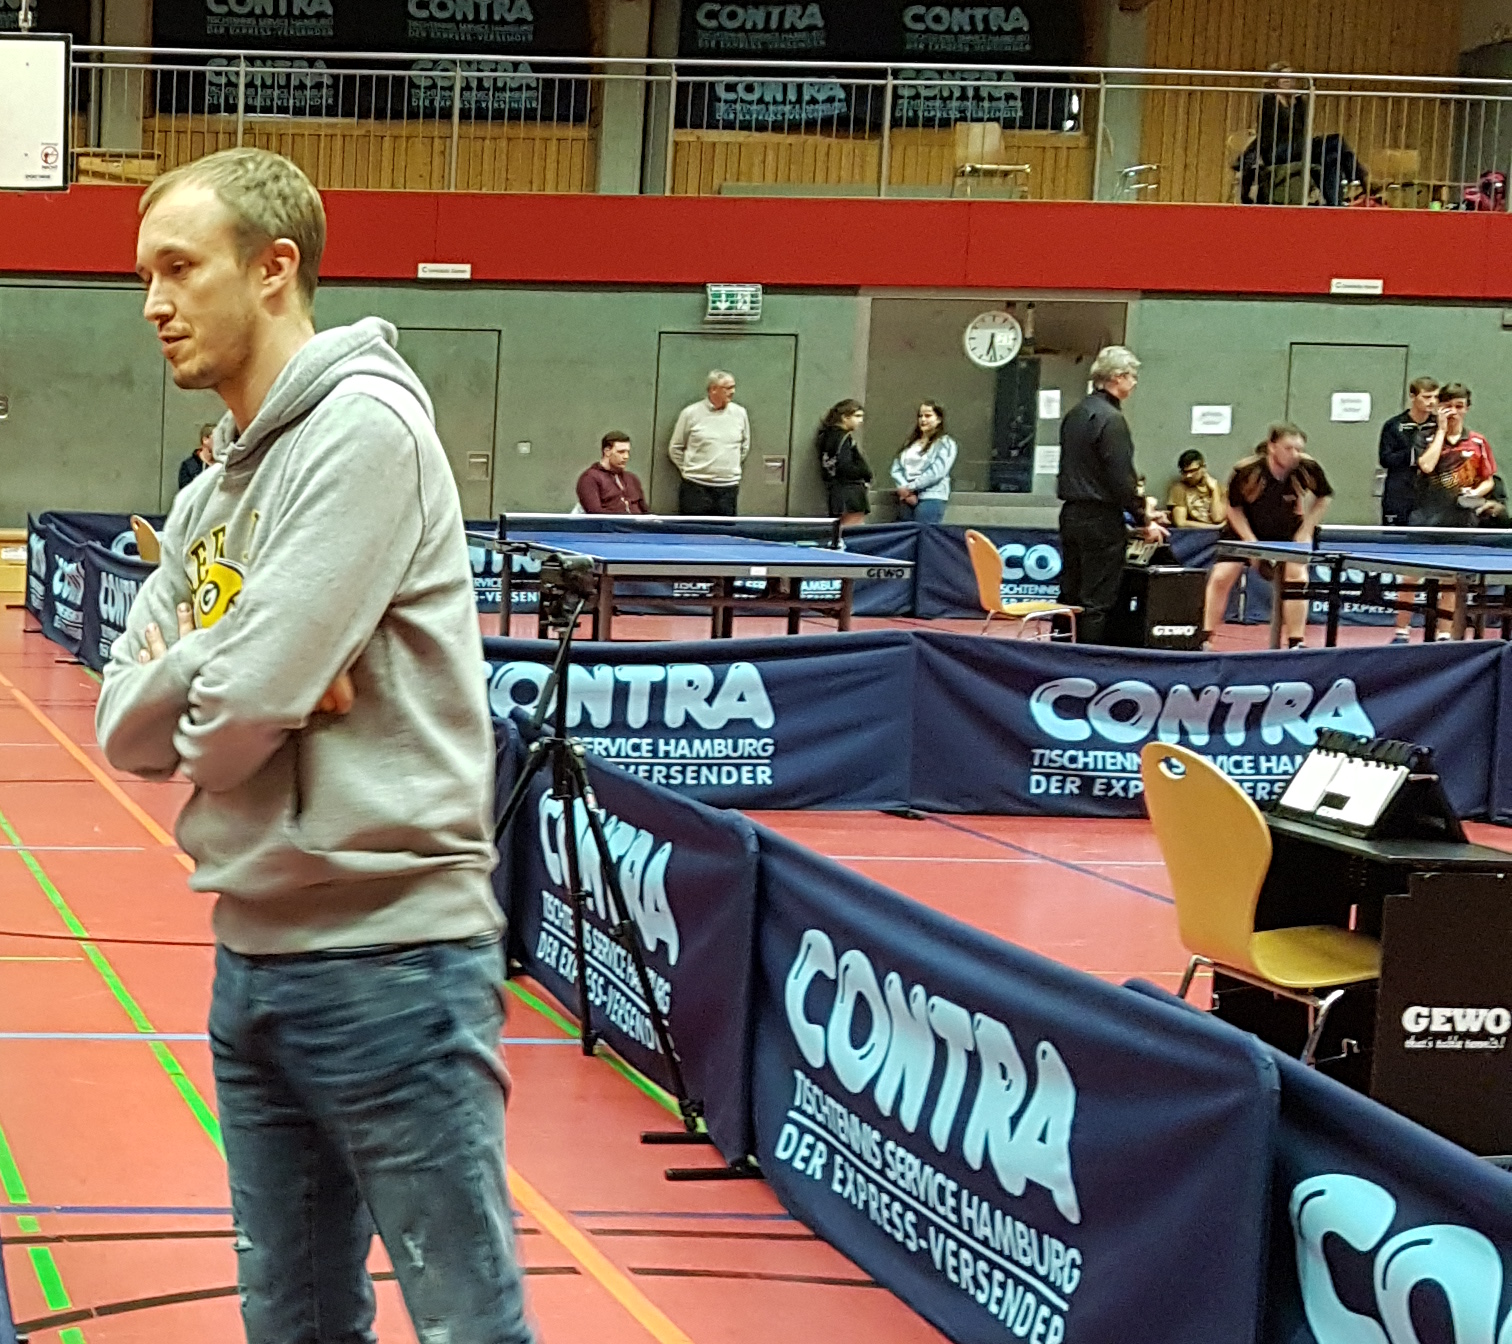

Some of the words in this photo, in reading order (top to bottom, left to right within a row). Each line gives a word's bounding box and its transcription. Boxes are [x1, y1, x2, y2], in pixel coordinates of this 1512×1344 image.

[696, 2, 825, 30] CONTRA
[904, 5, 1030, 32] CONTRA
[483, 661, 775, 730] ONTRA
[1030, 677, 1376, 746] CONTRA
[586, 737, 653, 758] ERVICE
[658, 737, 775, 758] HAMBURG
[1029, 774, 1082, 796] DER
[1401, 1005, 1512, 1035] GEWO
[785, 928, 1081, 1225] CONTRA
[774, 1123, 828, 1180] DER
[793, 1068, 883, 1170] TISCHTENNIS
[883, 1140, 959, 1224] SERVICE
[959, 1189, 1082, 1295] HAMBURG
